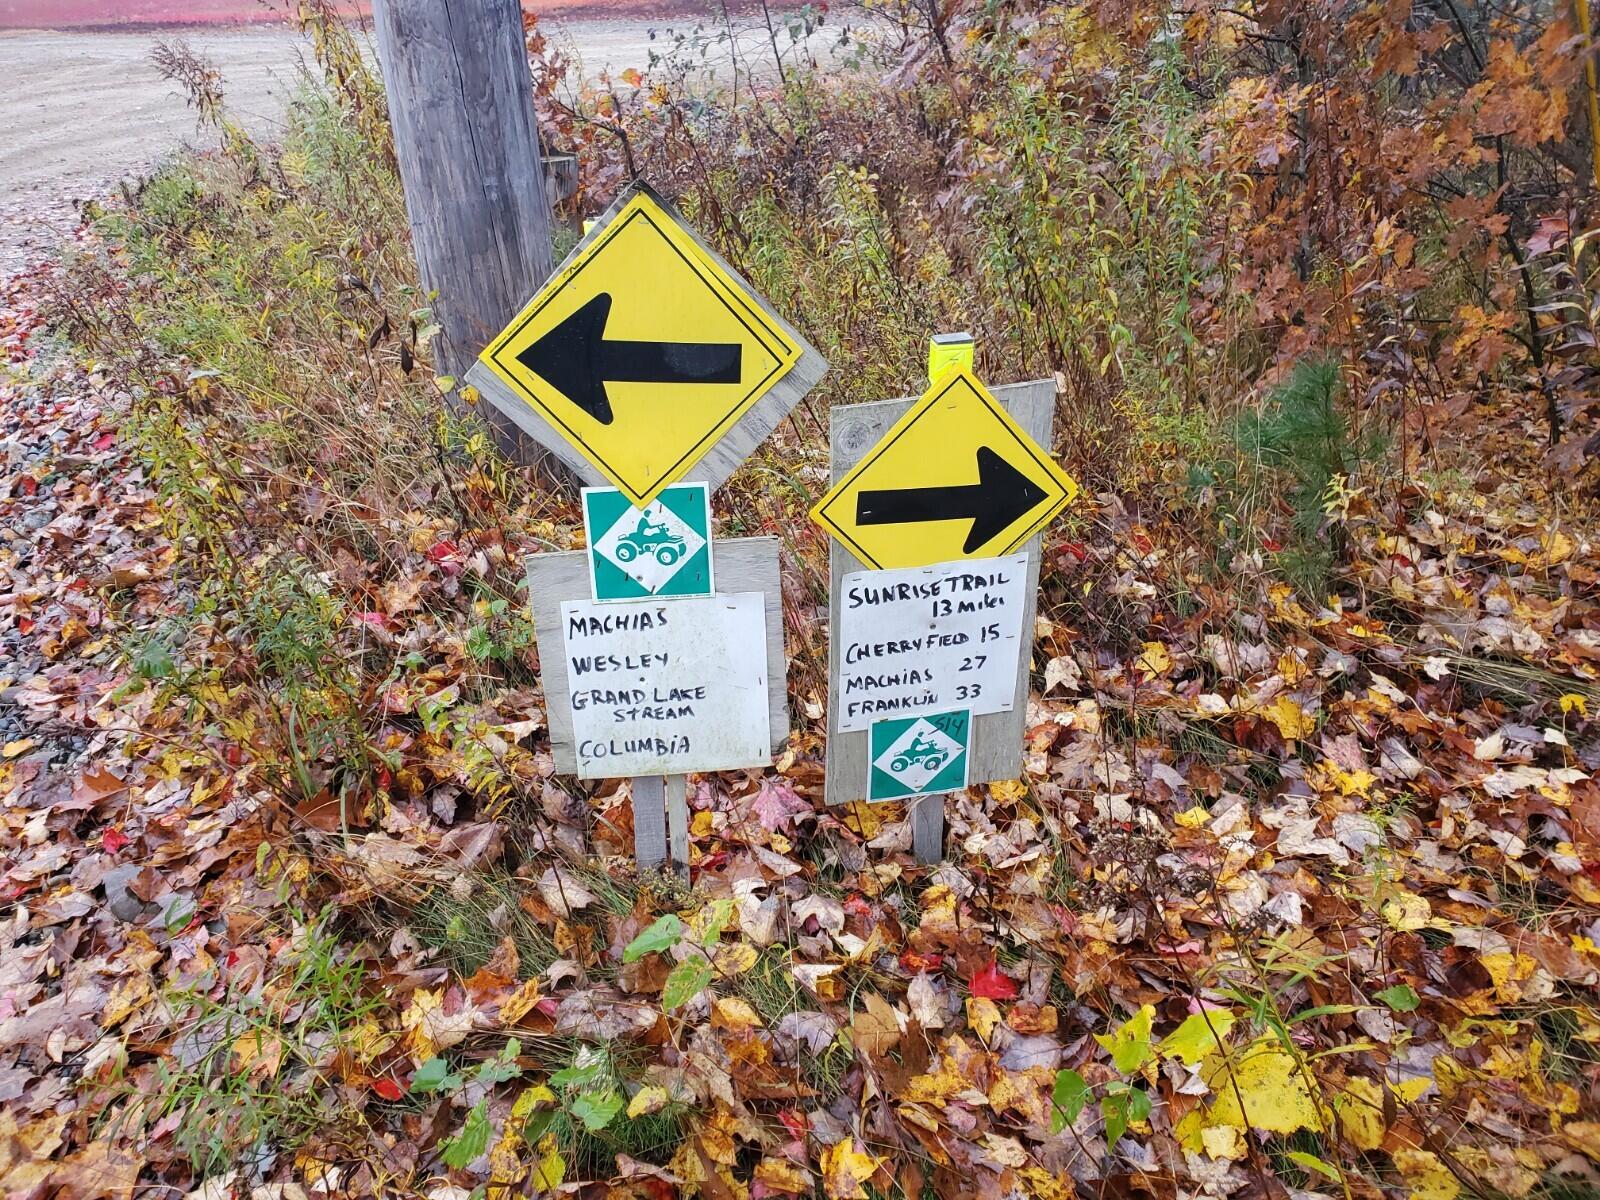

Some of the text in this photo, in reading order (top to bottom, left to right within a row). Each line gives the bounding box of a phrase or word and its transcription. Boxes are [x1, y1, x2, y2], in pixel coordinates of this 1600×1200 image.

[849, 573, 1010, 608] SUNRISE TRAIL
[933, 600, 952, 617] 13
[569, 610, 669, 640] MACHIAS
[981, 623, 1000, 643] 15
[572, 652, 668, 675] WESLEY
[958, 656, 987, 672] 27
[572, 687, 706, 711] GRAND LAKE
[956, 684, 982, 700] 33
